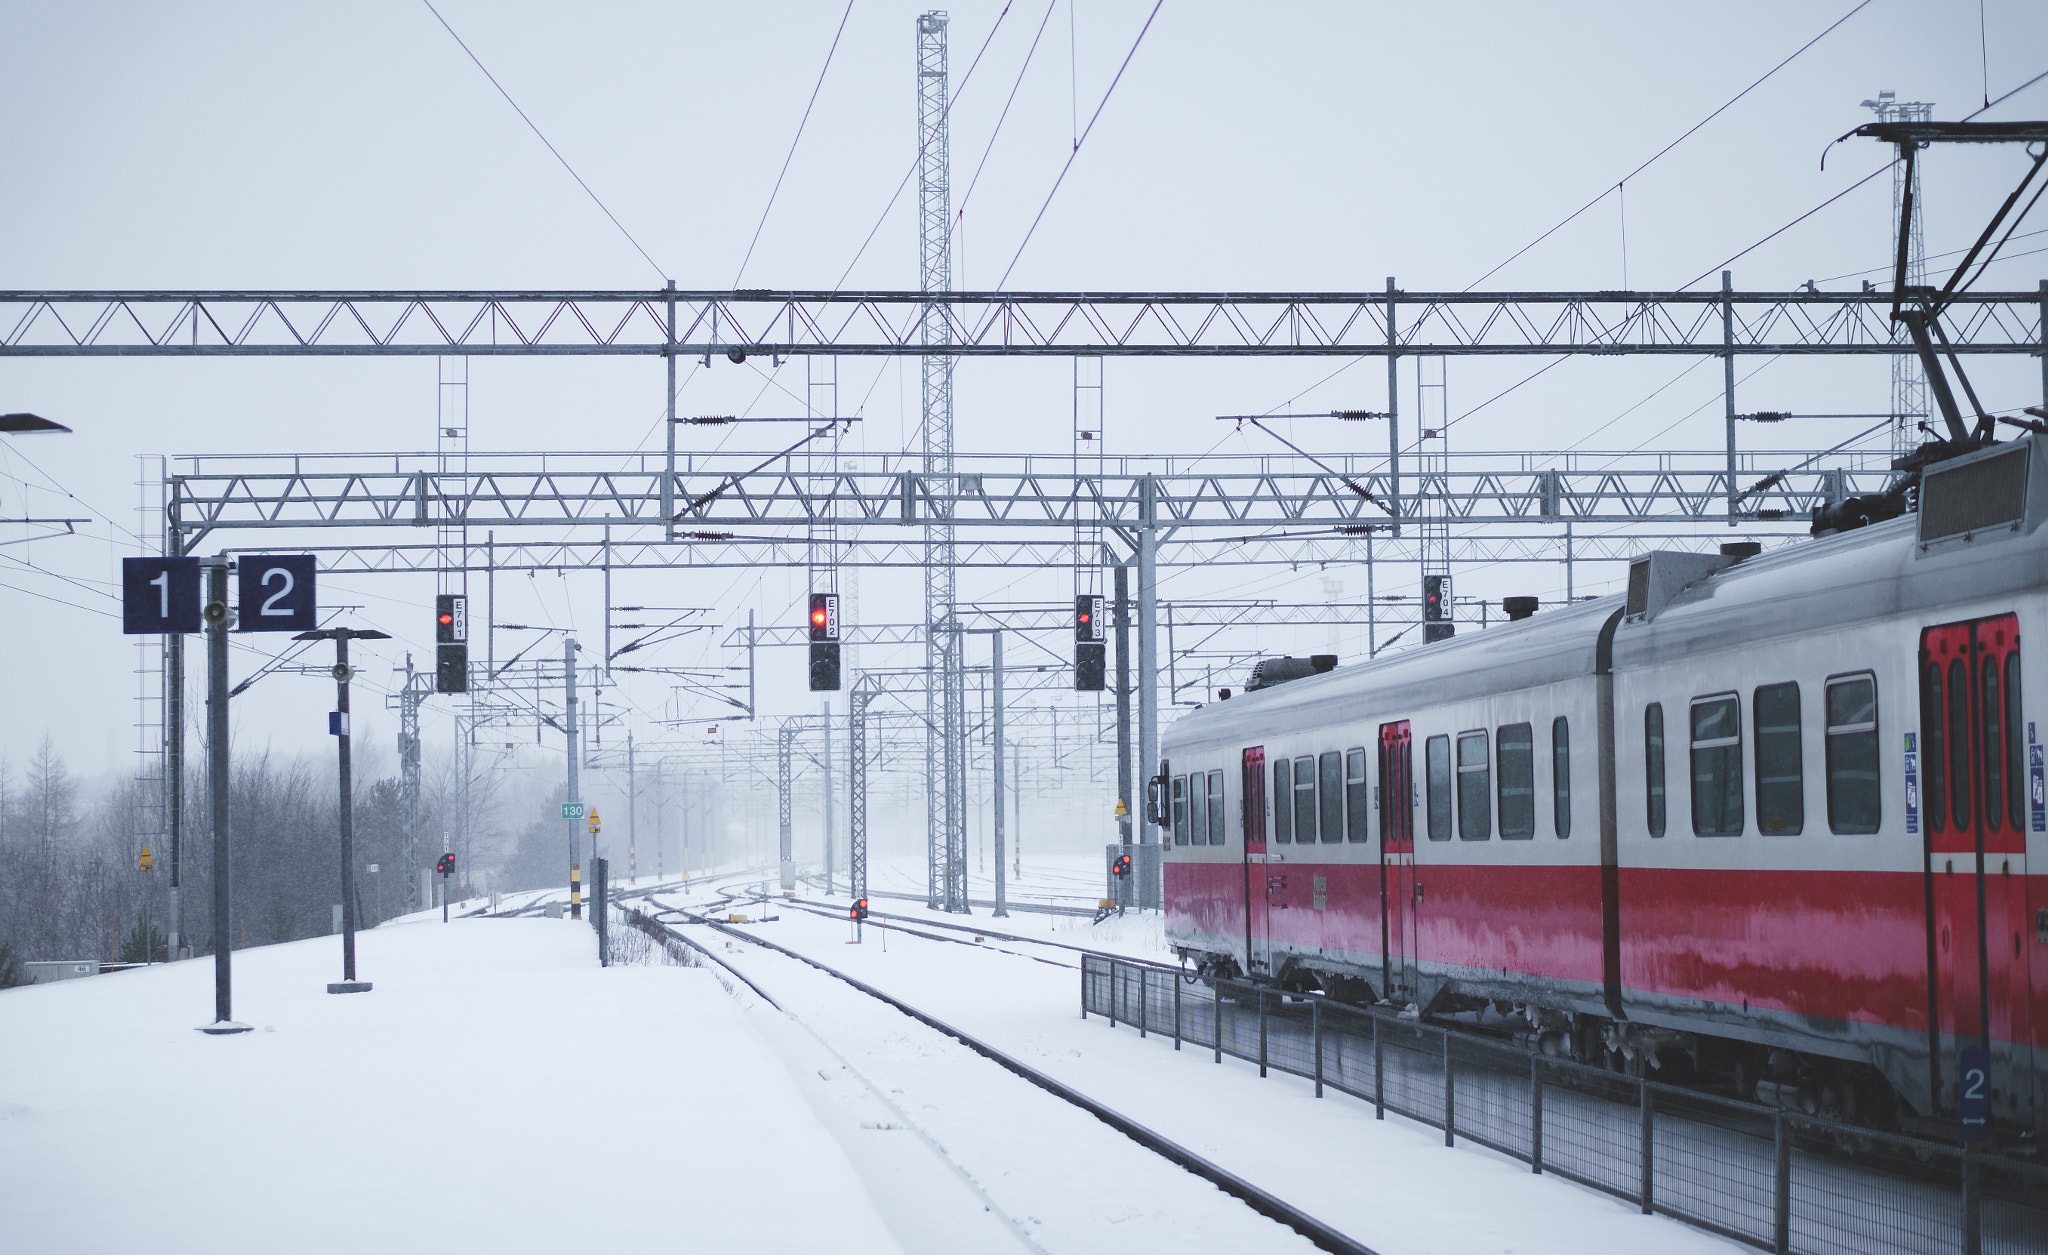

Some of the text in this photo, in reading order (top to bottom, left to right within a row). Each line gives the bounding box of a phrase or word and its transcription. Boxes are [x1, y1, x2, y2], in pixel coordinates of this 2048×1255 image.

[150, 571, 169, 618] 1
[260, 567, 295, 616] 2
[563, 806, 582, 816] 130
[1964, 1068, 1985, 1099] 2
